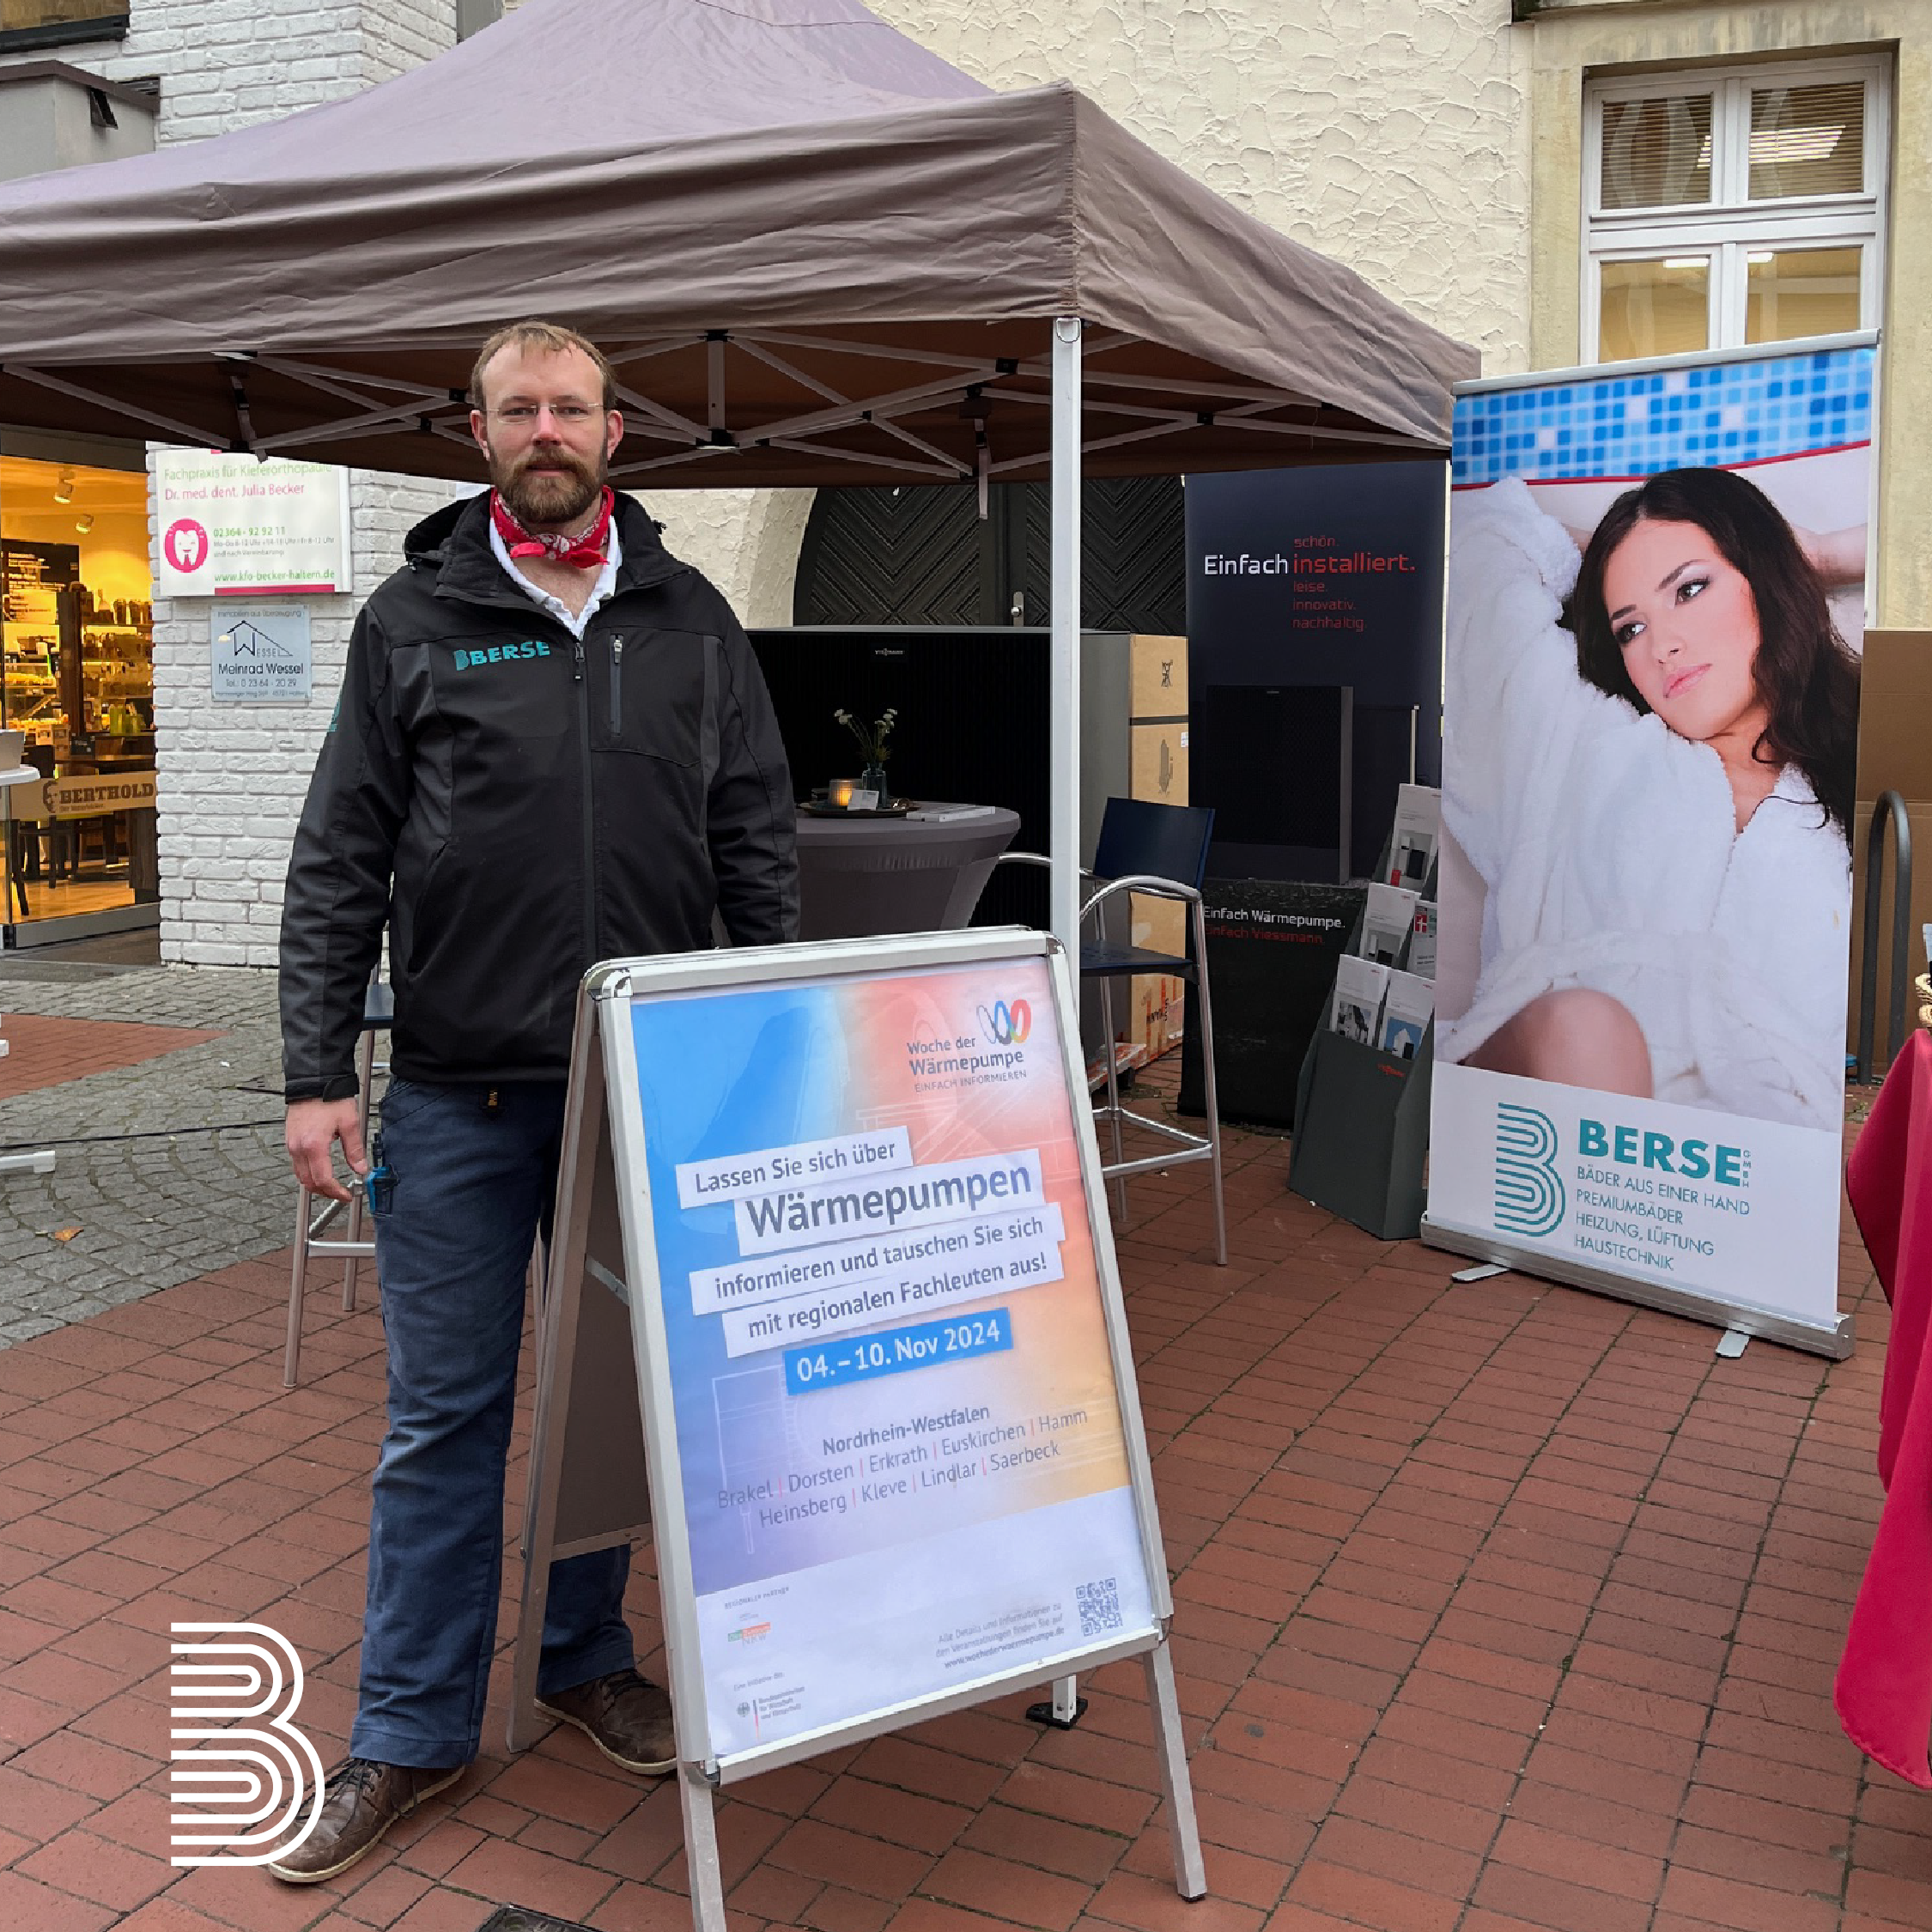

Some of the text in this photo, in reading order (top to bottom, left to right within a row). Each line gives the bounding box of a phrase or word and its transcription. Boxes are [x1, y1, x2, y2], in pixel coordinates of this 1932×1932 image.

[164, 466, 219, 481] Fachpraxis
[222, 465, 236, 477] für
[165, 483, 305, 500] Dr. med. dent. Julia Becker
[1294, 535, 1340, 548] schön.
[215, 568, 335, 581] www.kfo-becker-haltern.de
[1204, 551, 1415, 574] Einfach installiert.
[1293, 580, 1328, 592] leise.
[1292, 598, 1356, 611] innovativ.
[1292, 617, 1367, 632] nachhaltig.
[470, 641, 550, 665] BERSE
[218, 663, 304, 675] Meinrad Wessel
[60, 783, 154, 804] BERTHOLD
[1204, 906, 1346, 931] Einfach Wärmepumpe.
[1204, 923, 1249, 939] Einfach
[907, 1036, 975, 1054] Woche der
[909, 1051, 1024, 1075] Wärmepumpe
[914, 1069, 1026, 1092] EINFACH INFORMIEREN
[1577, 1118, 1741, 1187] BERSE
[696, 1143, 895, 1193] Lassen Sie sich über
[1577, 1163, 1750, 1215] BÄDER AUS EINER HAND
[744, 1166, 1031, 1237] Wärmepumpen
[1577, 1188, 1683, 1225] PREMIUMBÄDER
[1576, 1211, 1714, 1255] HEIZUNG, LÜFTUNG
[715, 1217, 1043, 1298] informieren und tauschen Sie sich
[1574, 1233, 1674, 1271] HAUSTECHNIK
[749, 1251, 1047, 1338] mit regionalen Fachleuten aus!
[895, 1337, 938, 1362] Nov
[944, 1319, 1001, 1352] 2024
[823, 1406, 990, 1455] Nordrhein-Westfalen
[718, 1410, 1088, 1509] Brakel Dorsten Erkrath Euskirchen Hamm
[759, 1440, 1061, 1528] Heinsberg Kleve Lindlar Saerbeck
